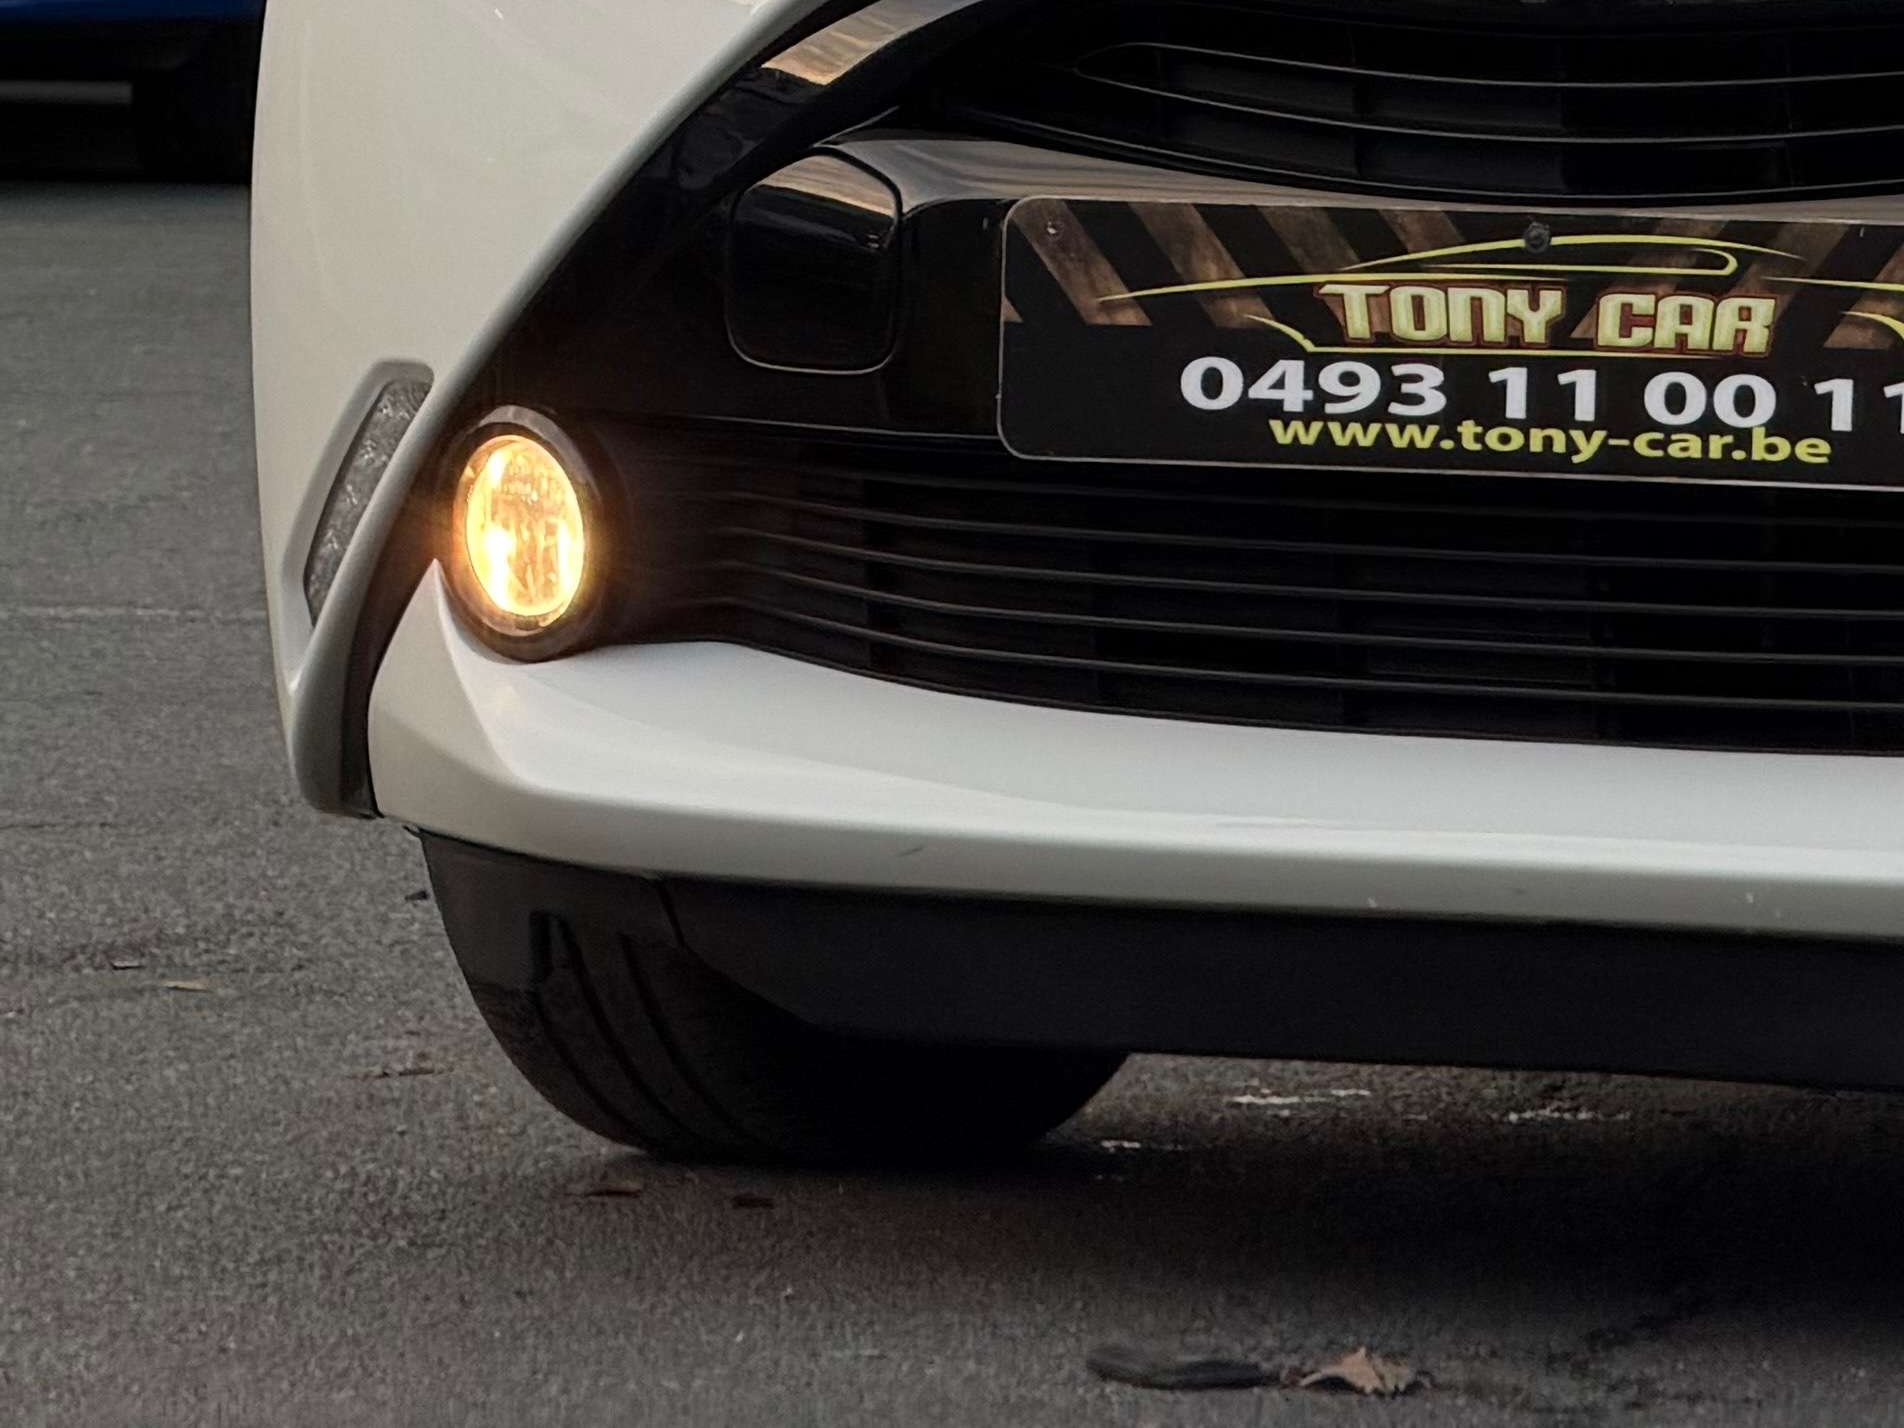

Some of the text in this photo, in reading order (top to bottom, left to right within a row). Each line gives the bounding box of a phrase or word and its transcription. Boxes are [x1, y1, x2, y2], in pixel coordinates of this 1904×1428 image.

[1317, 281, 1777, 355] TONY CAR
[1179, 355, 1448, 417] 0493
[1487, 366, 1598, 423] 11
[1643, 370, 1777, 428] 00
[1268, 418, 1833, 465] www.tony-car.be
